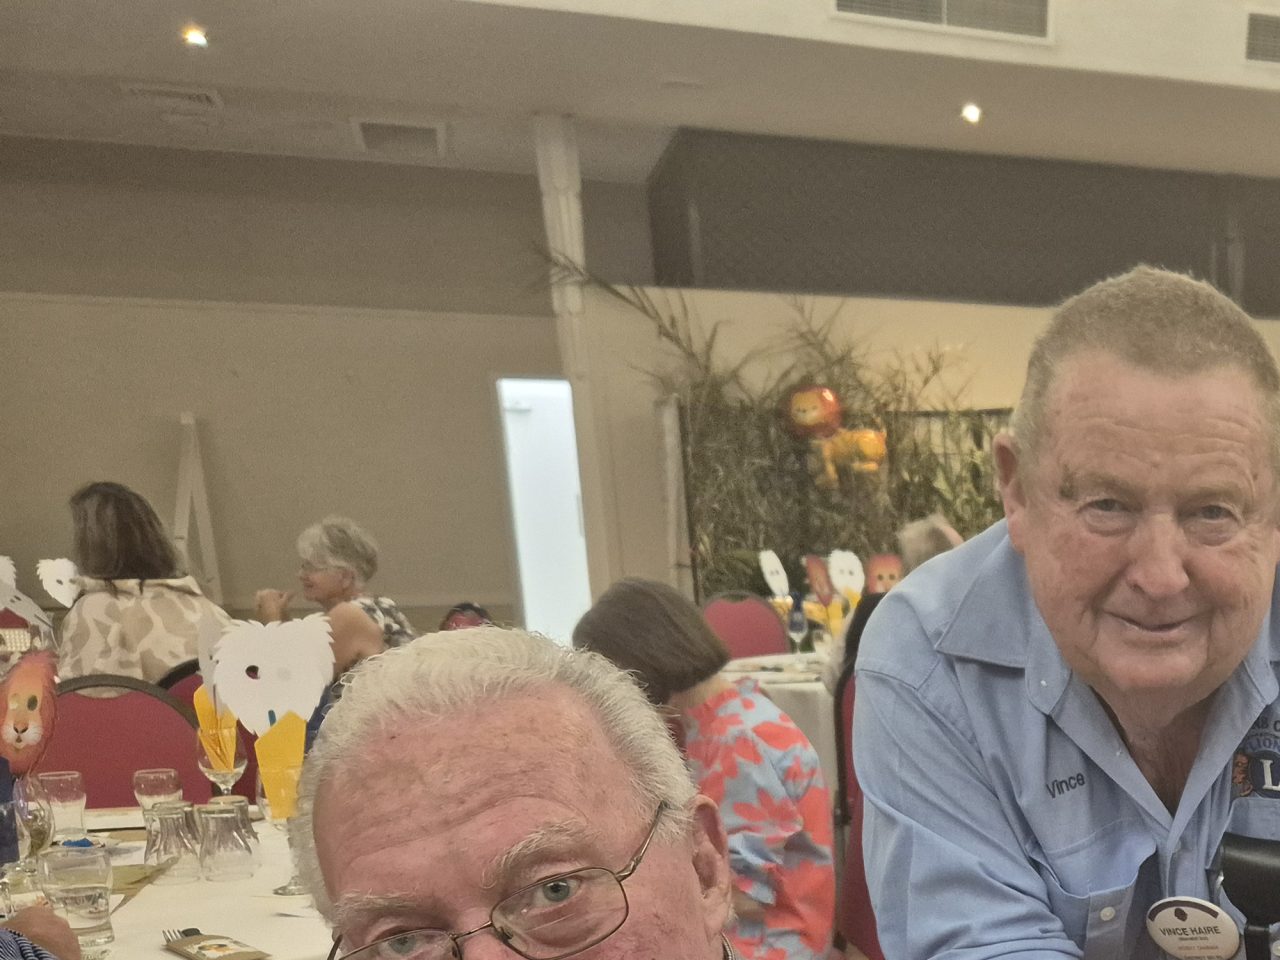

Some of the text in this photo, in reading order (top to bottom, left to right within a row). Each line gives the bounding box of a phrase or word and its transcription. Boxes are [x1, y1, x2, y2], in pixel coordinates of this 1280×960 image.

[1046, 772, 1086, 799] Vince
[1160, 926, 1222, 937] VINCE HAIRE
